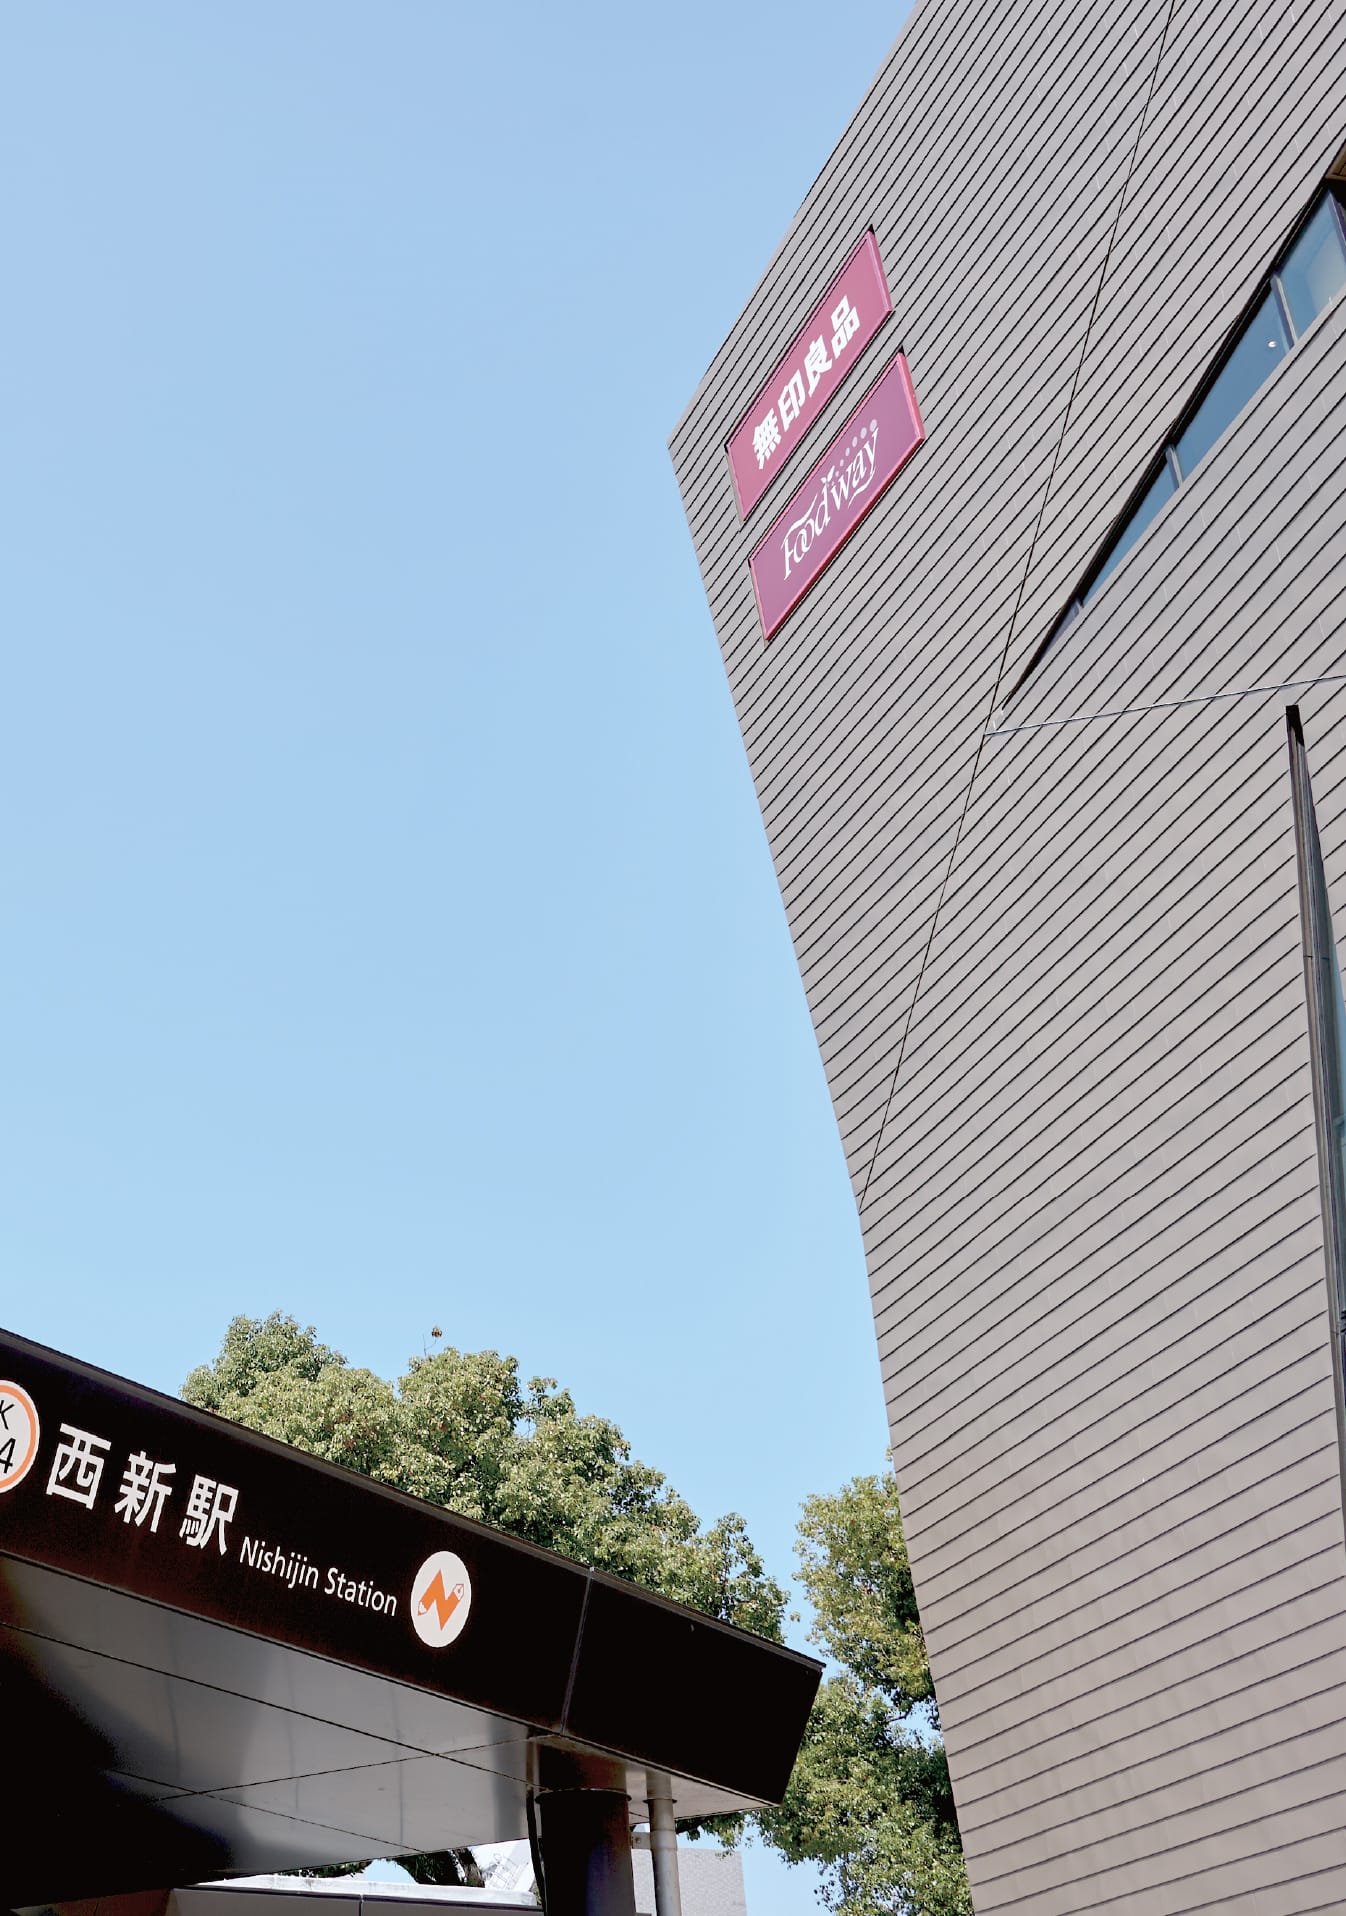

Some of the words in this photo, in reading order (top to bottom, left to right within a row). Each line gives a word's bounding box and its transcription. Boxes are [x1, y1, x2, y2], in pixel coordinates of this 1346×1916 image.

[752, 295, 861, 470] 無印良品
[781, 427, 879, 580] Foodway
[46, 1423, 239, 1556] 西新駅
[240, 1536, 319, 1590] Nishijin
[325, 1567, 398, 1616] Station
